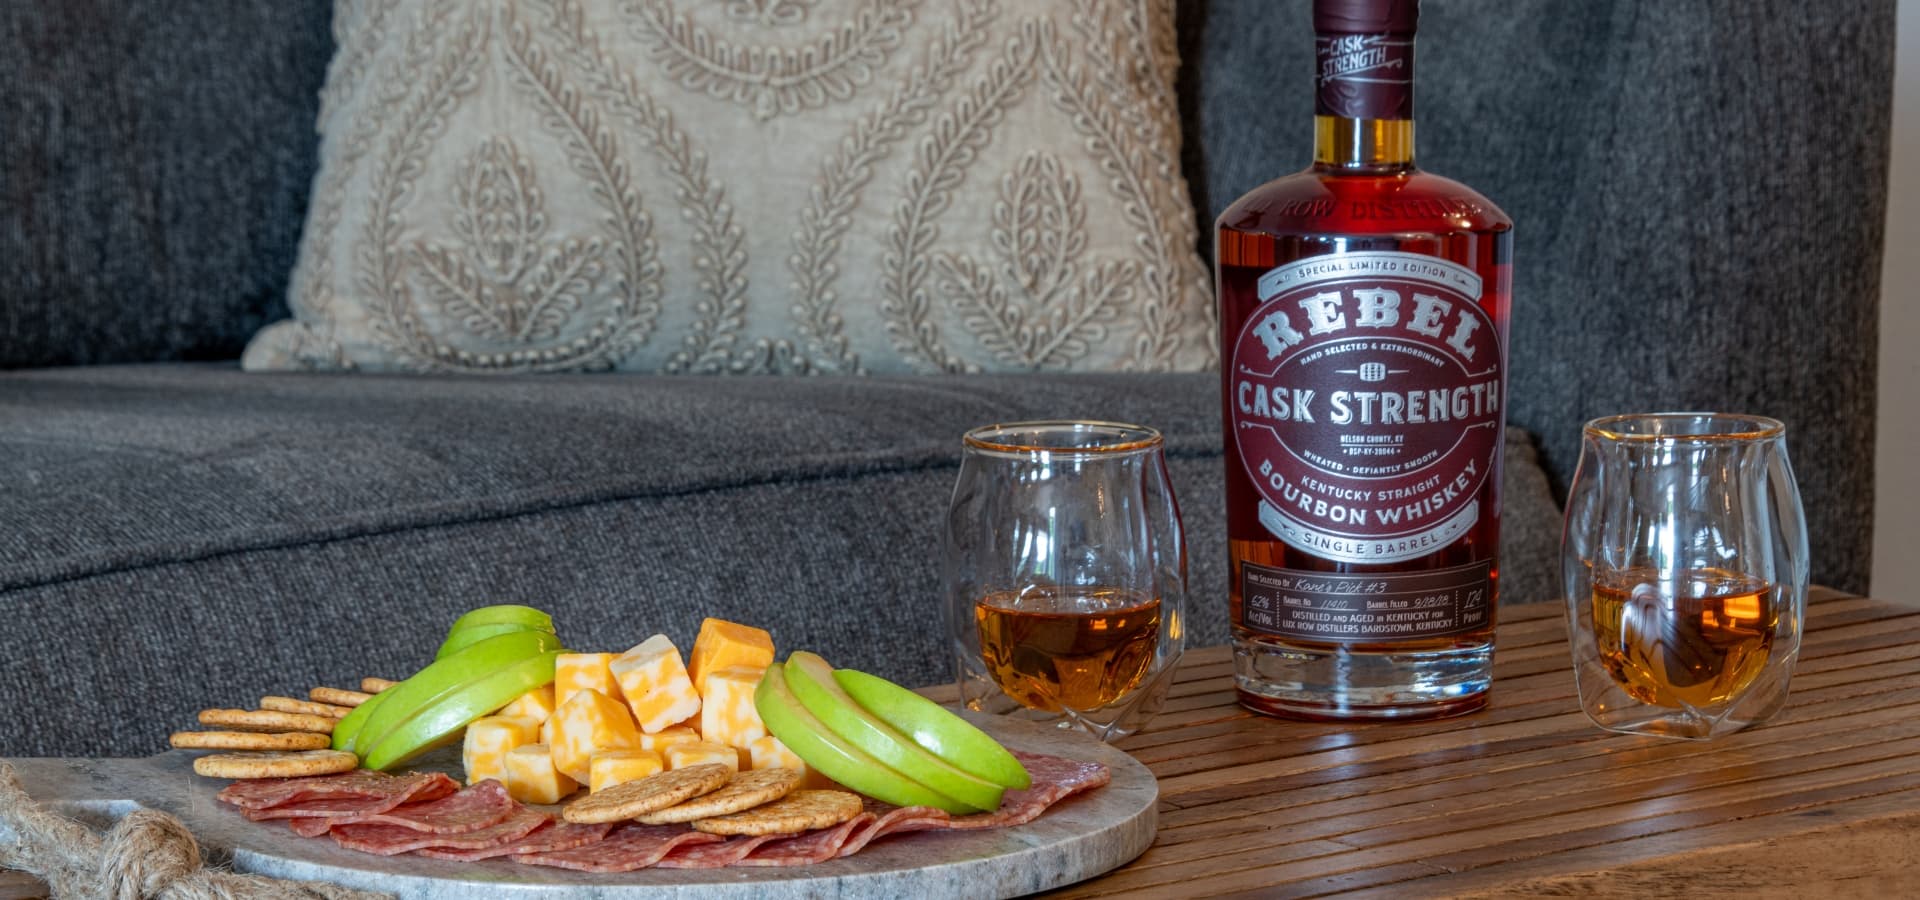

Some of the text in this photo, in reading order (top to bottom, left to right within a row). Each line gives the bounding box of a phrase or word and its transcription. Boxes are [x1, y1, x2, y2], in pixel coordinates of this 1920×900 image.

[1330, 35, 1364, 57] CASK
[1323, 46, 1387, 77] STRENGTH
[1299, 261, 1447, 279] SPECIAL LIMITED EDITION
[1251, 286, 1482, 363] REBEL
[1300, 342, 1446, 368] HAND SELECTED & EXTRAORDINARY
[1238, 379, 1499, 425] CASK STRENGTH
[1340, 434, 1365, 444] NELSON
[1395, 434, 1404, 443] KY
[1303, 449, 1438, 474] WHEATED DEFIANTLY SMOOTH
[1258, 458, 1477, 526] BOURBON WHISKEY
[1301, 474, 1442, 501] KENTUCKY STRAIGHT
[1303, 533, 1439, 554] SINGLE BARREL
[1335, 580, 1362, 593] Pick
[1364, 581, 1388, 594] #3
[1282, 620, 1296, 629] LUX
[1297, 621, 1314, 632] ROW
[1316, 623, 1359, 633] DISTILLERS
[1416, 619, 1453, 631] KENTUCKY
[1292, 610, 1330, 622] DISTILLED
[1333, 615, 1348, 623] AND
[1350, 614, 1374, 623] AGED
[1386, 611, 1430, 622] KENTUCKY
